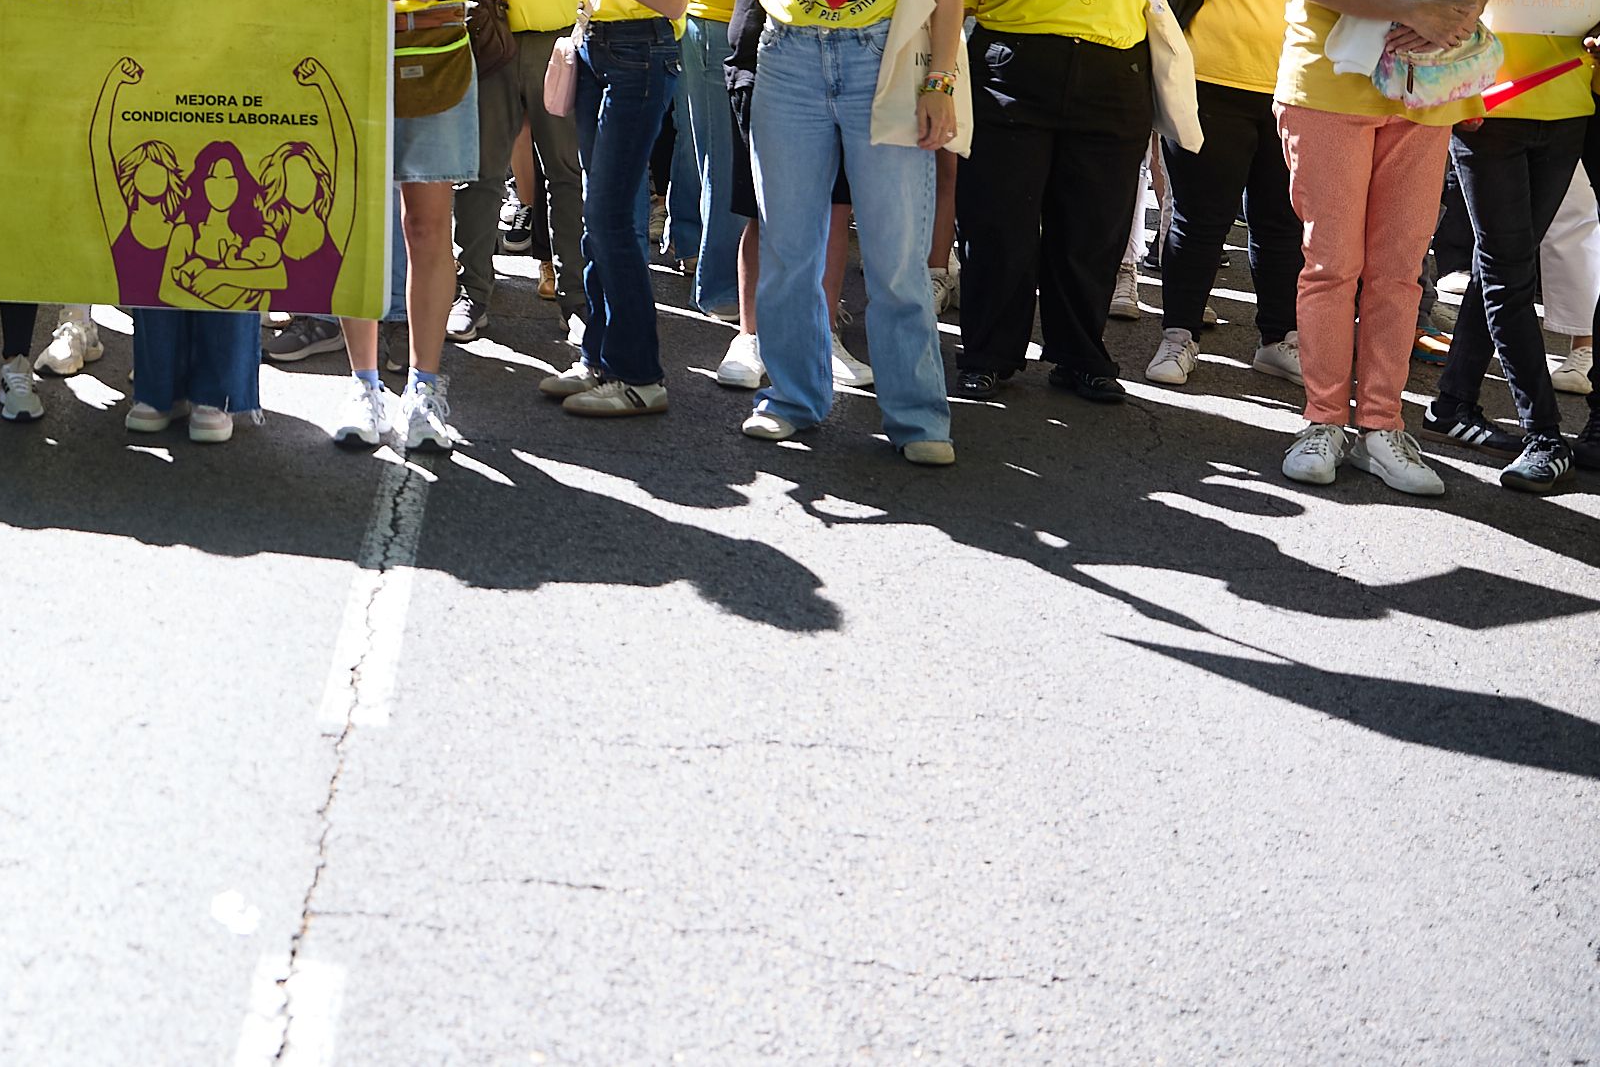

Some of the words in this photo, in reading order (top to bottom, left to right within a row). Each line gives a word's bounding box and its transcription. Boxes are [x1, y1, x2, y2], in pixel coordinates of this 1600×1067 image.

[175, 94, 238, 107] MEJORA
[242, 95, 263, 108] DE
[121, 110, 225, 125] CONDICIONES
[228, 112, 320, 127] LABORALES
